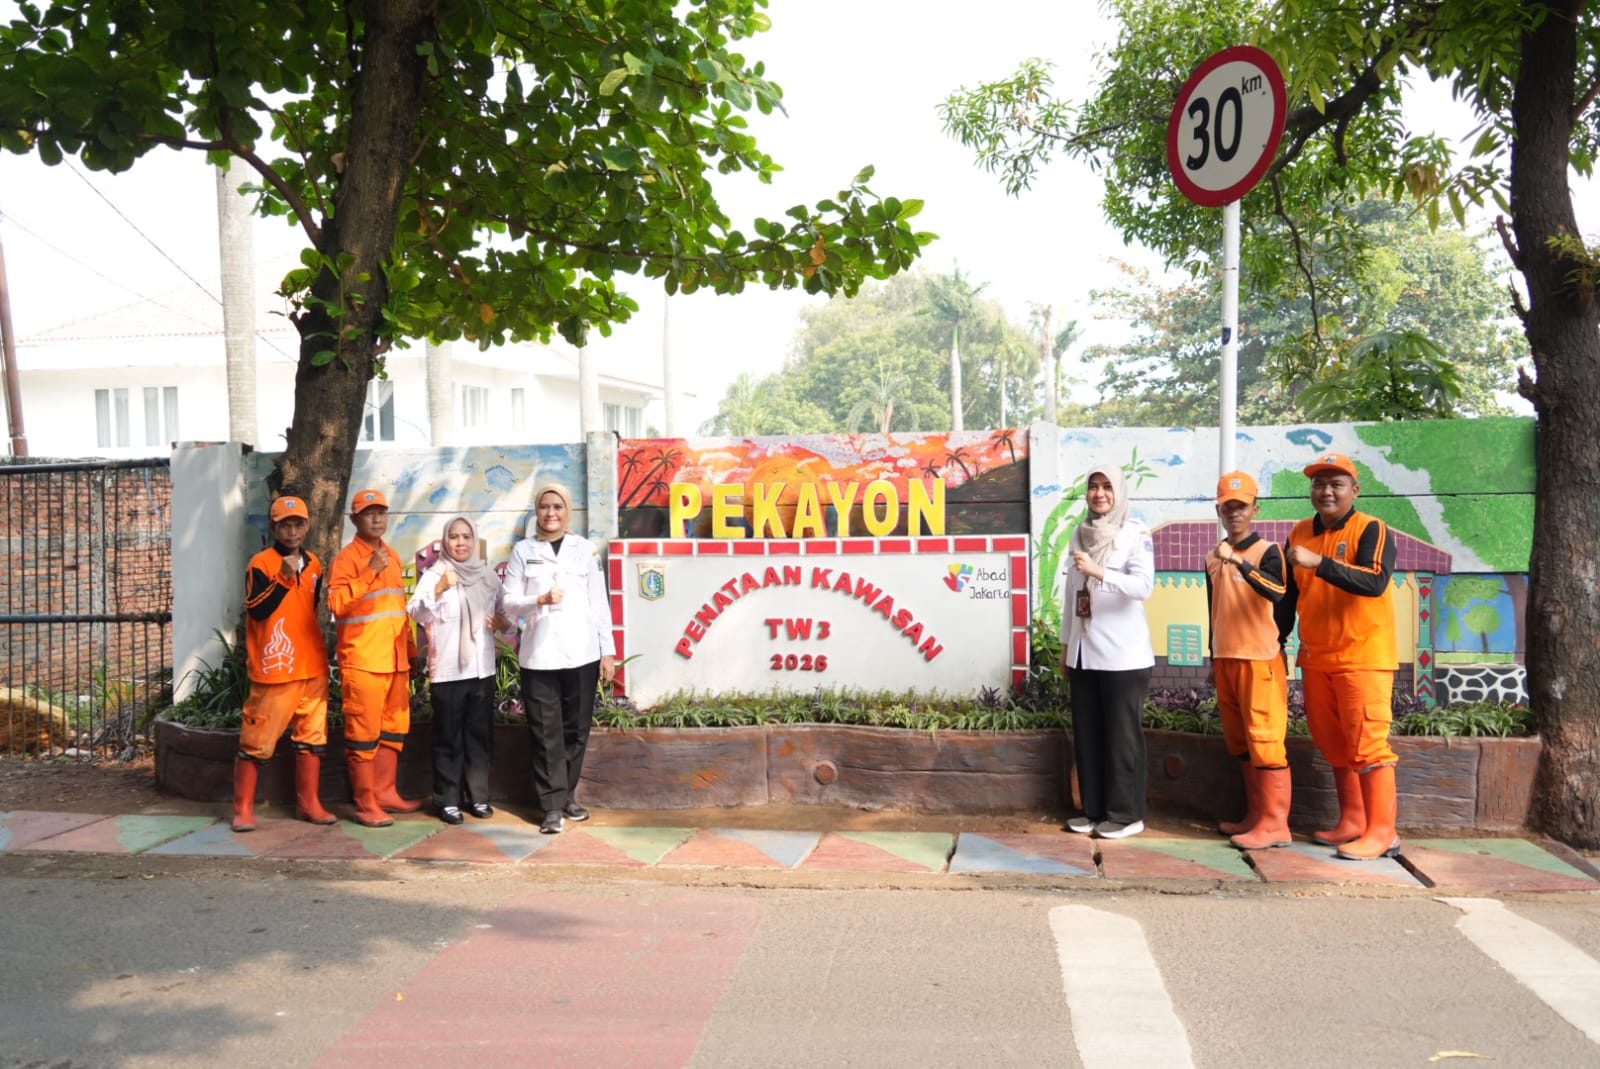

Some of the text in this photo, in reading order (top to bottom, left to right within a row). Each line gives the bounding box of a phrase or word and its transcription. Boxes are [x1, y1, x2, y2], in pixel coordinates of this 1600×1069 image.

[1186, 75, 1262, 170] 30 km
[669, 478, 946, 539] PEKAYON
[969, 586, 1010, 600] Jakarta
[976, 568, 1007, 581] Abad
[674, 565, 945, 662] PENATAAN KAWASAN
[770, 653, 829, 673] 2026
